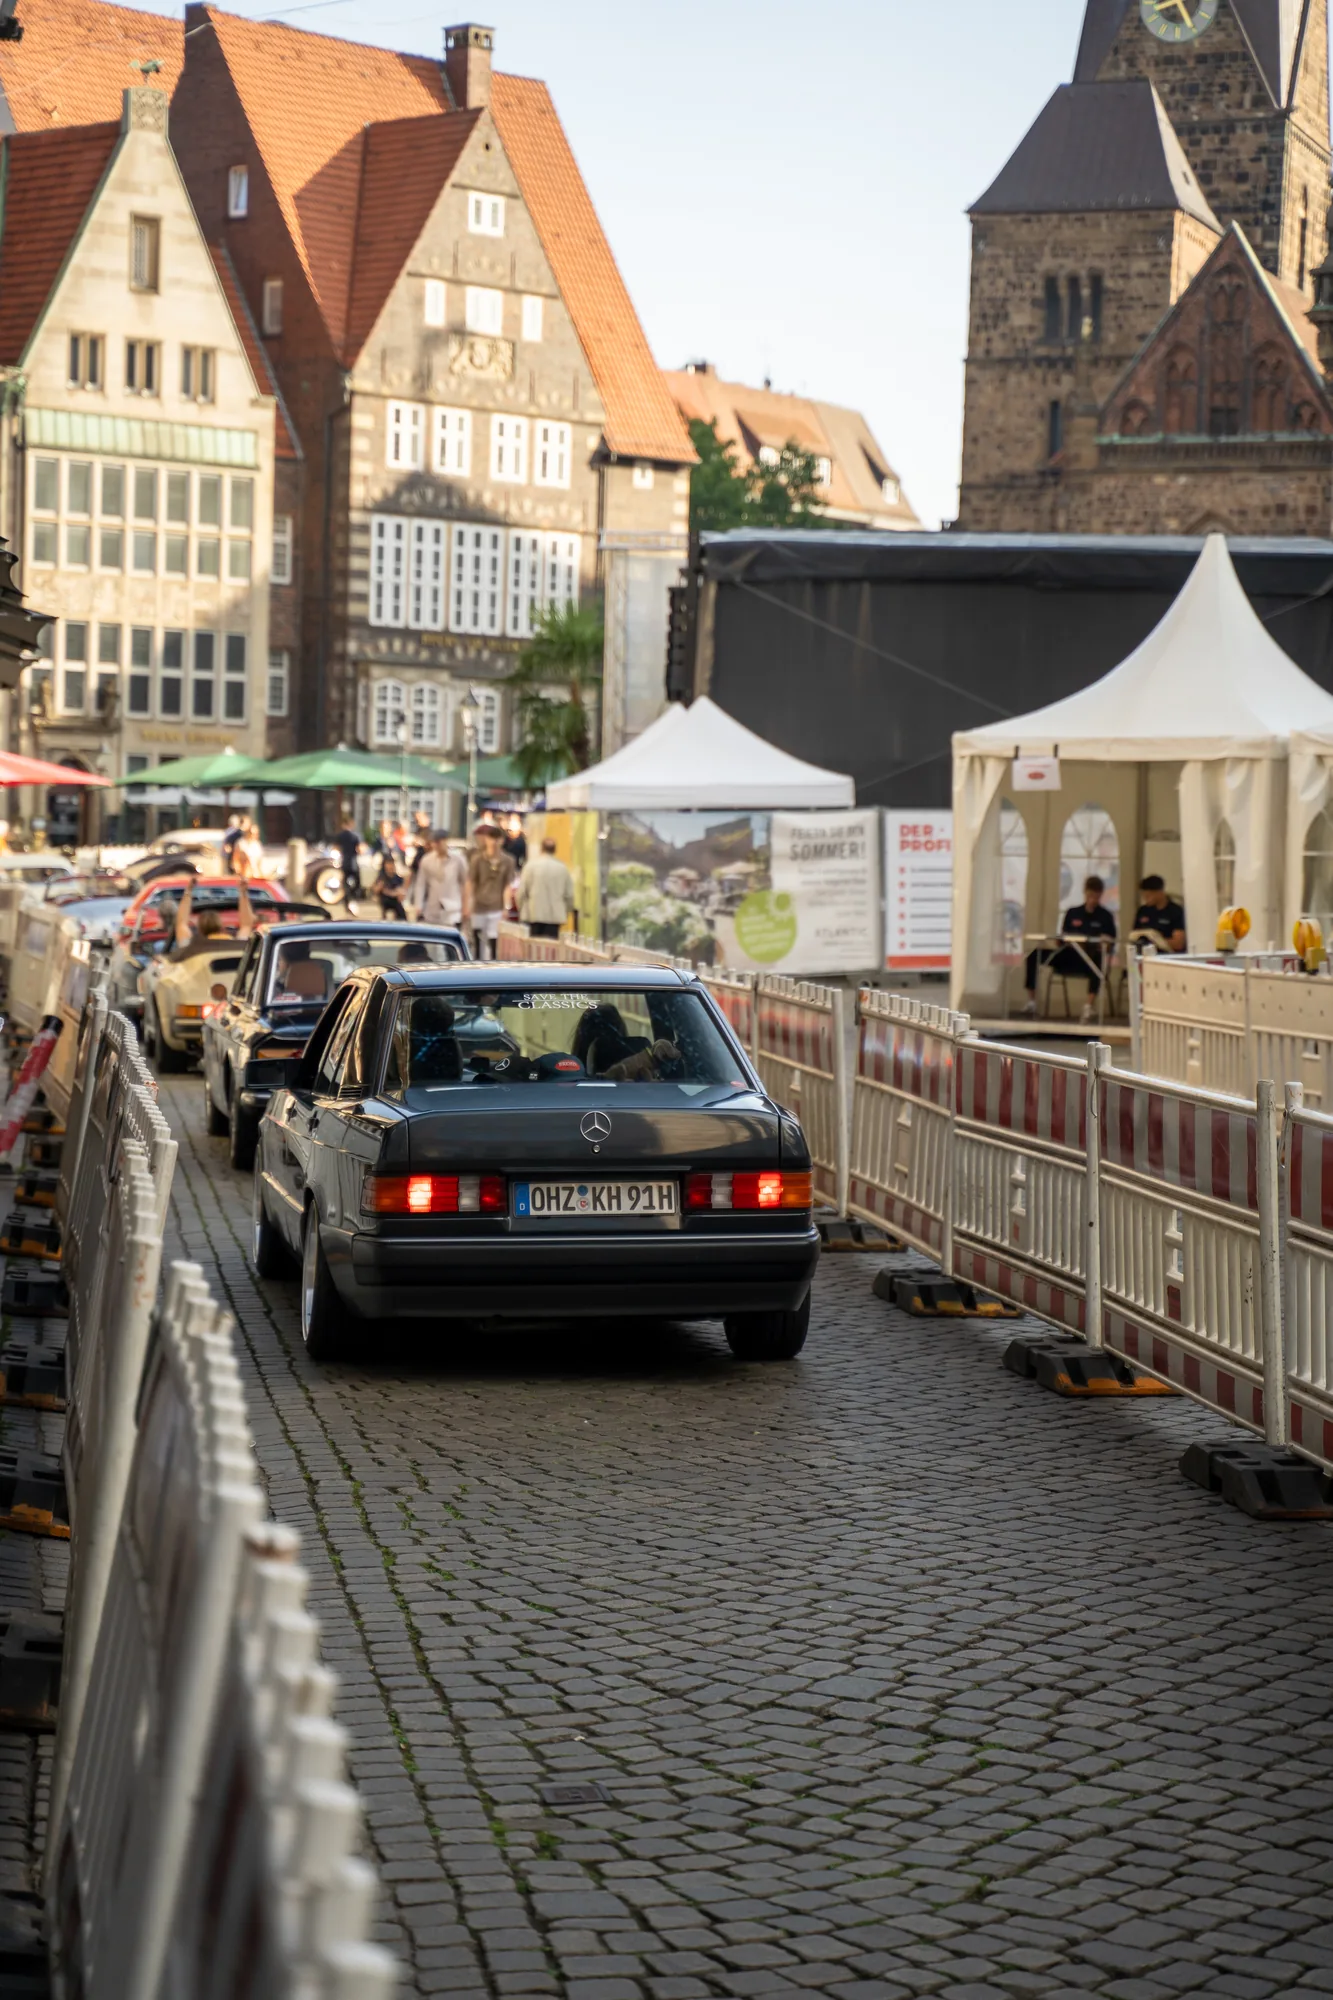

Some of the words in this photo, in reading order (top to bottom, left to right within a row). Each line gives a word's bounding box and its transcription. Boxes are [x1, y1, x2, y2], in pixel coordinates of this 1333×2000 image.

[899, 824, 933, 837] DER
[789, 841, 866, 862] SOMMER!
[523, 993, 556, 1001] SAVE
[517, 1001, 598, 1009] CLASSICS
[519, 1202, 526, 1211] D
[531, 1186, 576, 1211] OHZ
[591, 1186, 622, 1211] KH
[627, 1185, 673, 1211] 91H
